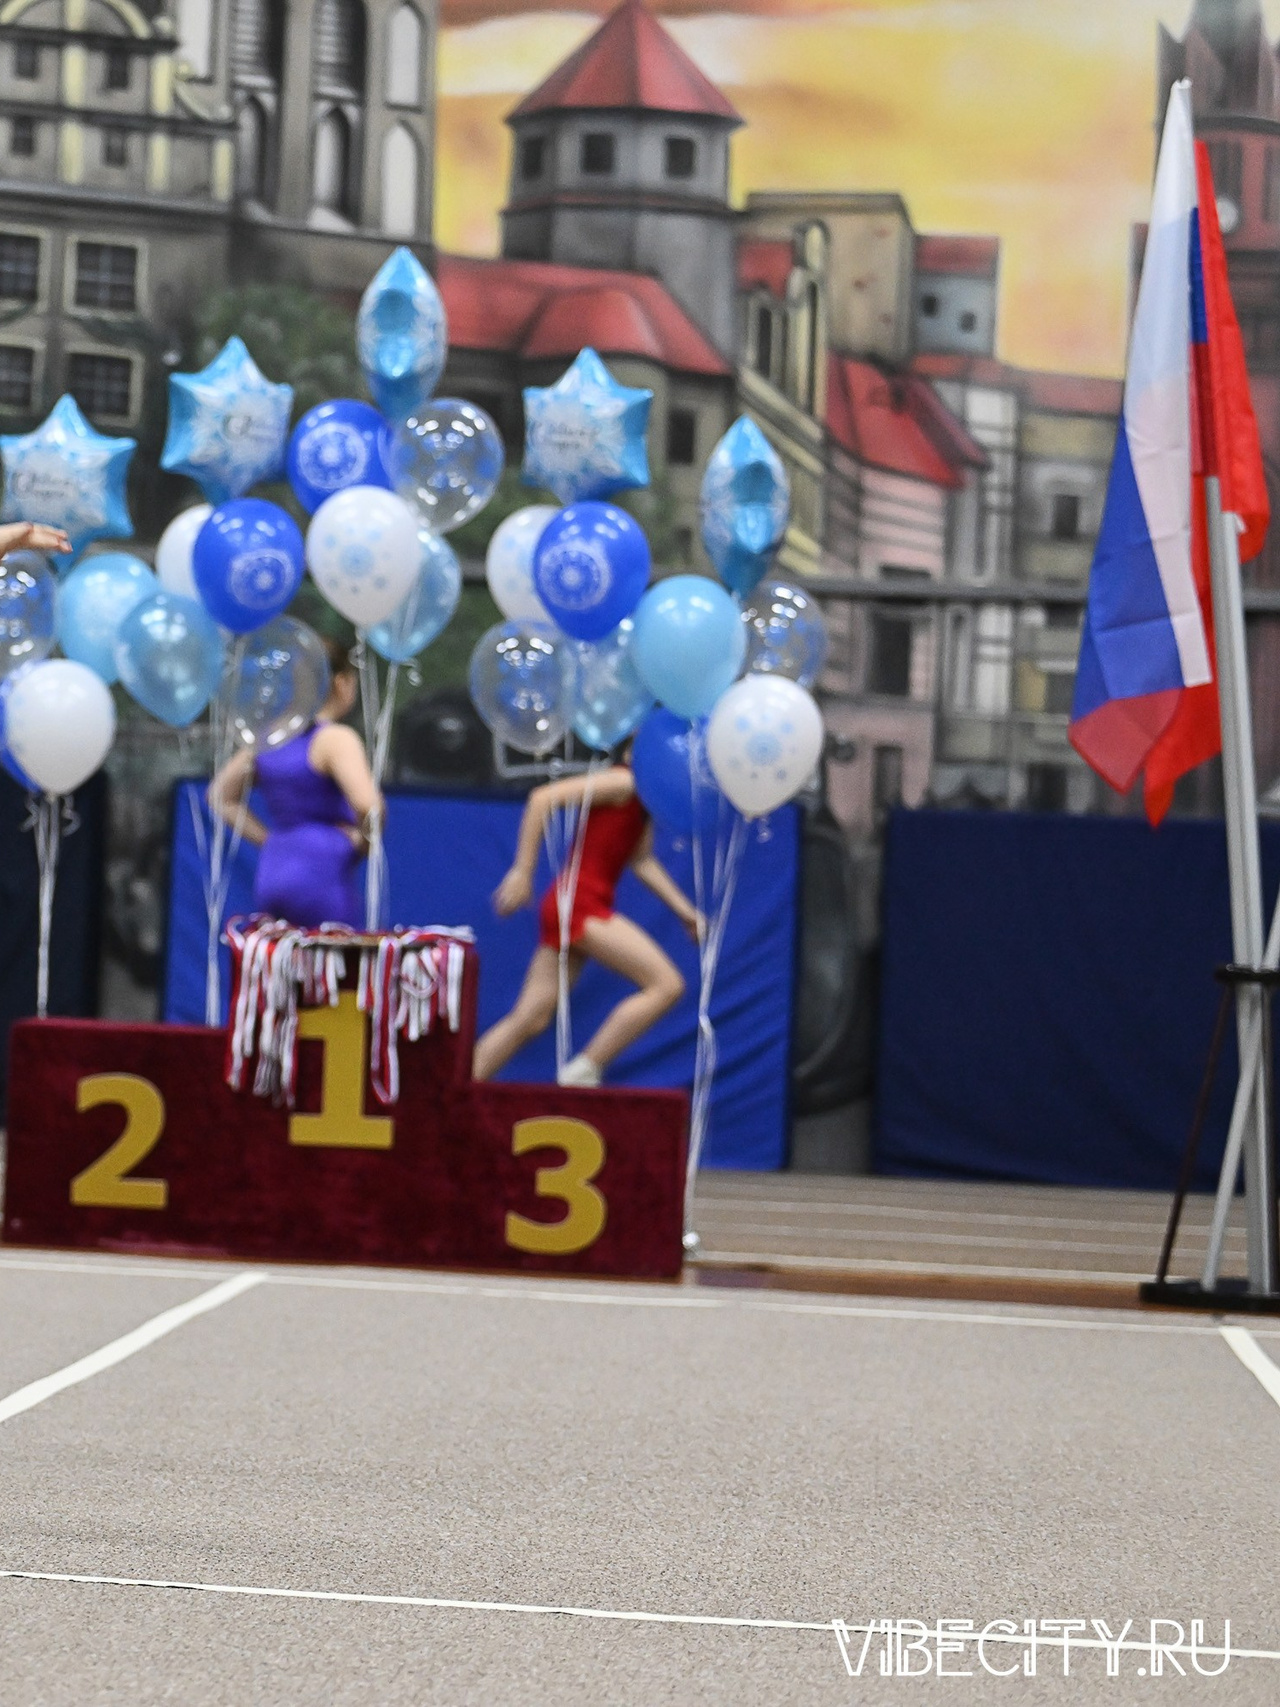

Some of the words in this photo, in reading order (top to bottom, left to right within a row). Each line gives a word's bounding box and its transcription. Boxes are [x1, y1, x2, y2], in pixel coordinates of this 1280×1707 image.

[289, 990, 394, 1149] 1
[71, 1074, 168, 1208] 2
[506, 1117, 607, 1254] 3
